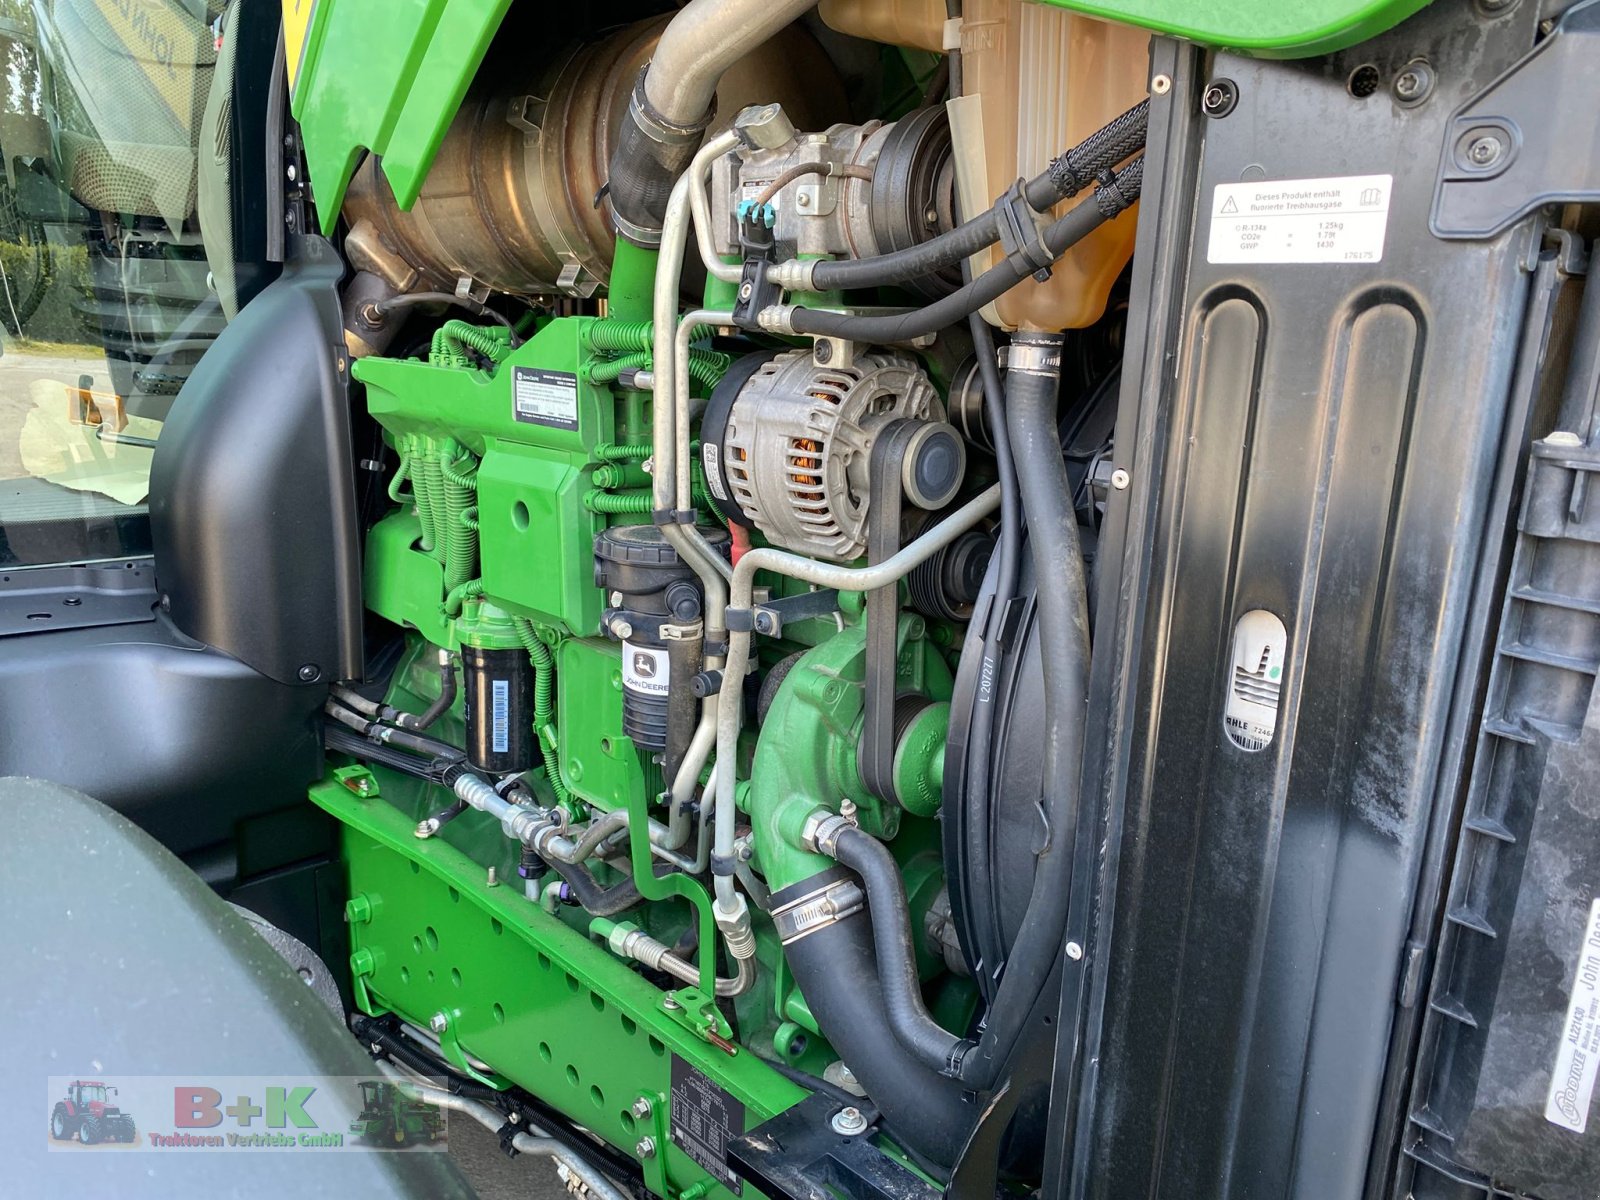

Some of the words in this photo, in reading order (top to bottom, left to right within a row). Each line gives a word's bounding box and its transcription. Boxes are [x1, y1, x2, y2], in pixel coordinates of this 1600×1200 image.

[1255, 193, 1280, 201] Dieses
[1281, 191, 1312, 200] Produkt
[1313, 189, 1341, 199] enthält
[1250, 202, 1284, 212] fluorierte
[1286, 200, 1343, 210] Treibhausgase
[1240, 242, 1259, 250] GWP
[1316, 241, 1335, 249] 1430
[981, 655, 994, 694] 207277
[626, 676, 641, 688] JOHN
[641, 680, 670, 692] DEERE
[1579, 955, 1600, 991] John
[1568, 1006, 1586, 1046] AL221430
